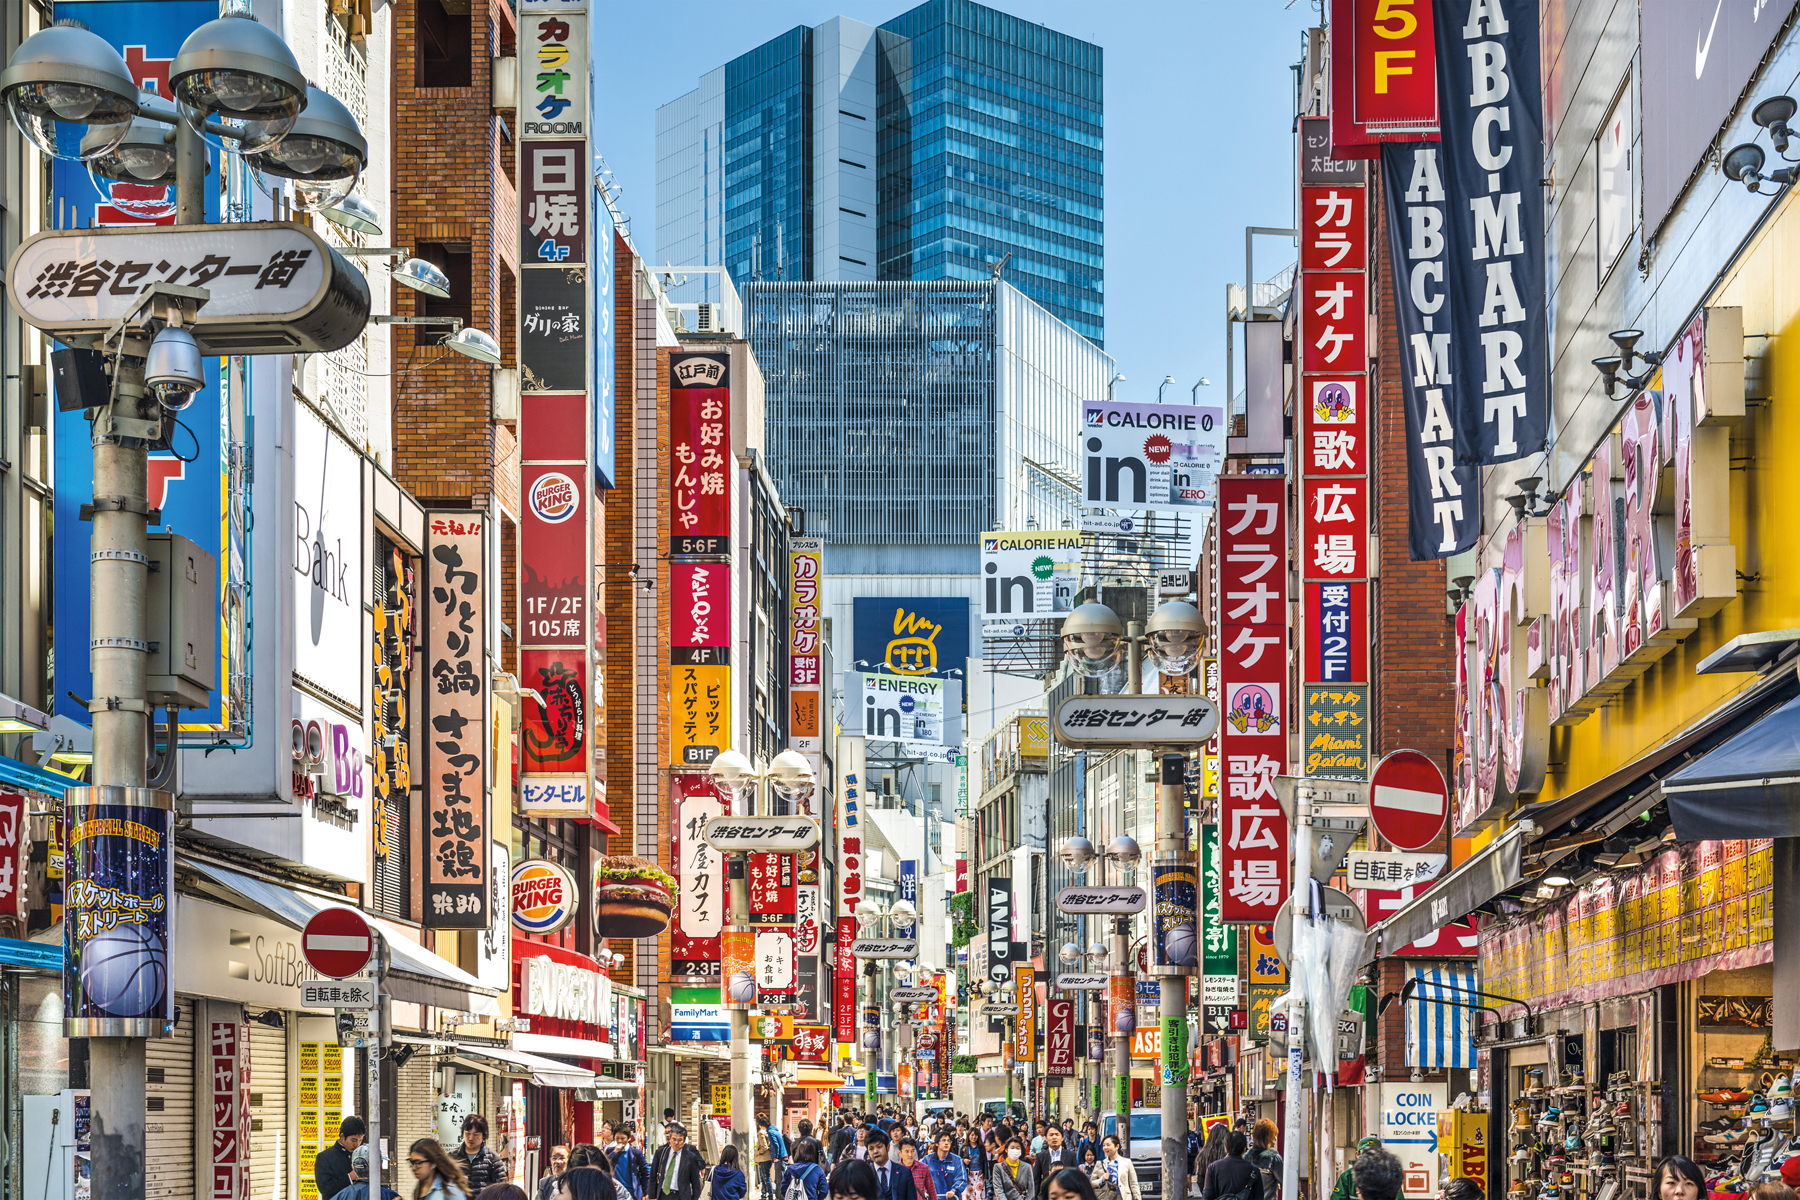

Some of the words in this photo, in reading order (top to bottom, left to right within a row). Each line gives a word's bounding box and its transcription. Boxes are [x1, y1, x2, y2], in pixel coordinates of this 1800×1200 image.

[1372, 0, 1417, 94] 5F
[536, 17, 571, 120] カラオケ
[525, 121, 582, 134] ROOM
[1311, 155, 1357, 173] 太田ビル
[528, 149, 578, 237] 日焼
[1463, 0, 1526, 457] ABC-MART
[538, 239, 570, 261] 4F
[27, 249, 312, 299] 渋谷センター街
[1315, 191, 1354, 363] カラオケ
[524, 312, 580, 337] ダリの家
[1404, 149, 1464, 553] ABC-MART
[679, 364, 719, 380] 江戸前
[1107, 411, 1196, 431] CALORIE
[700, 398, 724, 495] お好み焼
[1148, 446, 1170, 454] NEW!
[1087, 437, 1147, 503] in
[1173, 469, 1190, 487] in
[536, 482, 571, 500] BURGER
[674, 443, 698, 529] もんじゃ
[1179, 489, 1206, 500] ZERO
[537, 490, 573, 511] KING
[1313, 430, 1356, 575] 歌広場
[1083, 520, 1120, 529] hit-ad.co.jp
[1000, 539, 1055, 551] CALORIE
[985, 562, 1033, 613] in
[1056, 583, 1069, 597] in
[1161, 574, 1188, 588] 白馬ビル
[1226, 494, 1281, 669] カラオケ
[791, 553, 818, 654] カラオケ
[529, 620, 580, 637] 105席
[1321, 585, 1349, 680] 受付2F
[691, 649, 710, 662] 4F
[794, 657, 816, 669] 受付
[794, 669, 816, 683] 3F
[879, 679, 937, 695] ENERGY
[683, 668, 697, 743] スパゲッティ
[706, 685, 720, 736] ピッツァ
[807, 698, 815, 731] Miyama
[866, 695, 900, 738] in
[915, 717, 926, 728] in
[1064, 708, 1210, 727] 渋谷センター街
[799, 739, 811, 748] 2F
[1309, 733, 1363, 751] Miami
[688, 749, 713, 760] B1F
[907, 750, 947, 759] hit-ad.co.jp
[523, 784, 585, 803] センタービル
[123, 820, 160, 850] STREET
[711, 826, 813, 839] 渋谷センター街
[1228, 753, 1282, 907] 歌広場
[765, 853, 778, 903] お好み焼
[781, 855, 792, 887] 江戸前
[512, 876, 562, 897] BURGER
[751, 867, 764, 912] もんじゃ
[512, 887, 563, 914] KING
[1062, 893, 1142, 905] 渋谷センター街
[79, 911, 147, 938] ストリート
[991, 888, 1009, 959] ANAP
[776, 936, 784, 974] ケーキと
[854, 944, 915, 953] 渋谷センター街
[764, 955, 773, 985] お食事
[1255, 953, 1280, 976] 松
[1060, 977, 1108, 985] 渋谷センター街
[305, 986, 370, 1003] 自転車を除く
[675, 1008, 718, 1018] FamilyMart
[1018, 975, 1033, 1056] プリクラのメッカ
[691, 1030, 701, 1040] 酒
[1051, 1002, 1070, 1065] GAME
[1273, 1020, 1286, 1030] 75
[794, 1029, 825, 1052] すき家
[1048, 1066, 1073, 1074] 渋谷会館
[212, 1023, 236, 1195] キャッシュ
[1396, 1093, 1432, 1107] COIN
[1387, 1112, 1438, 1125] LOCKE
